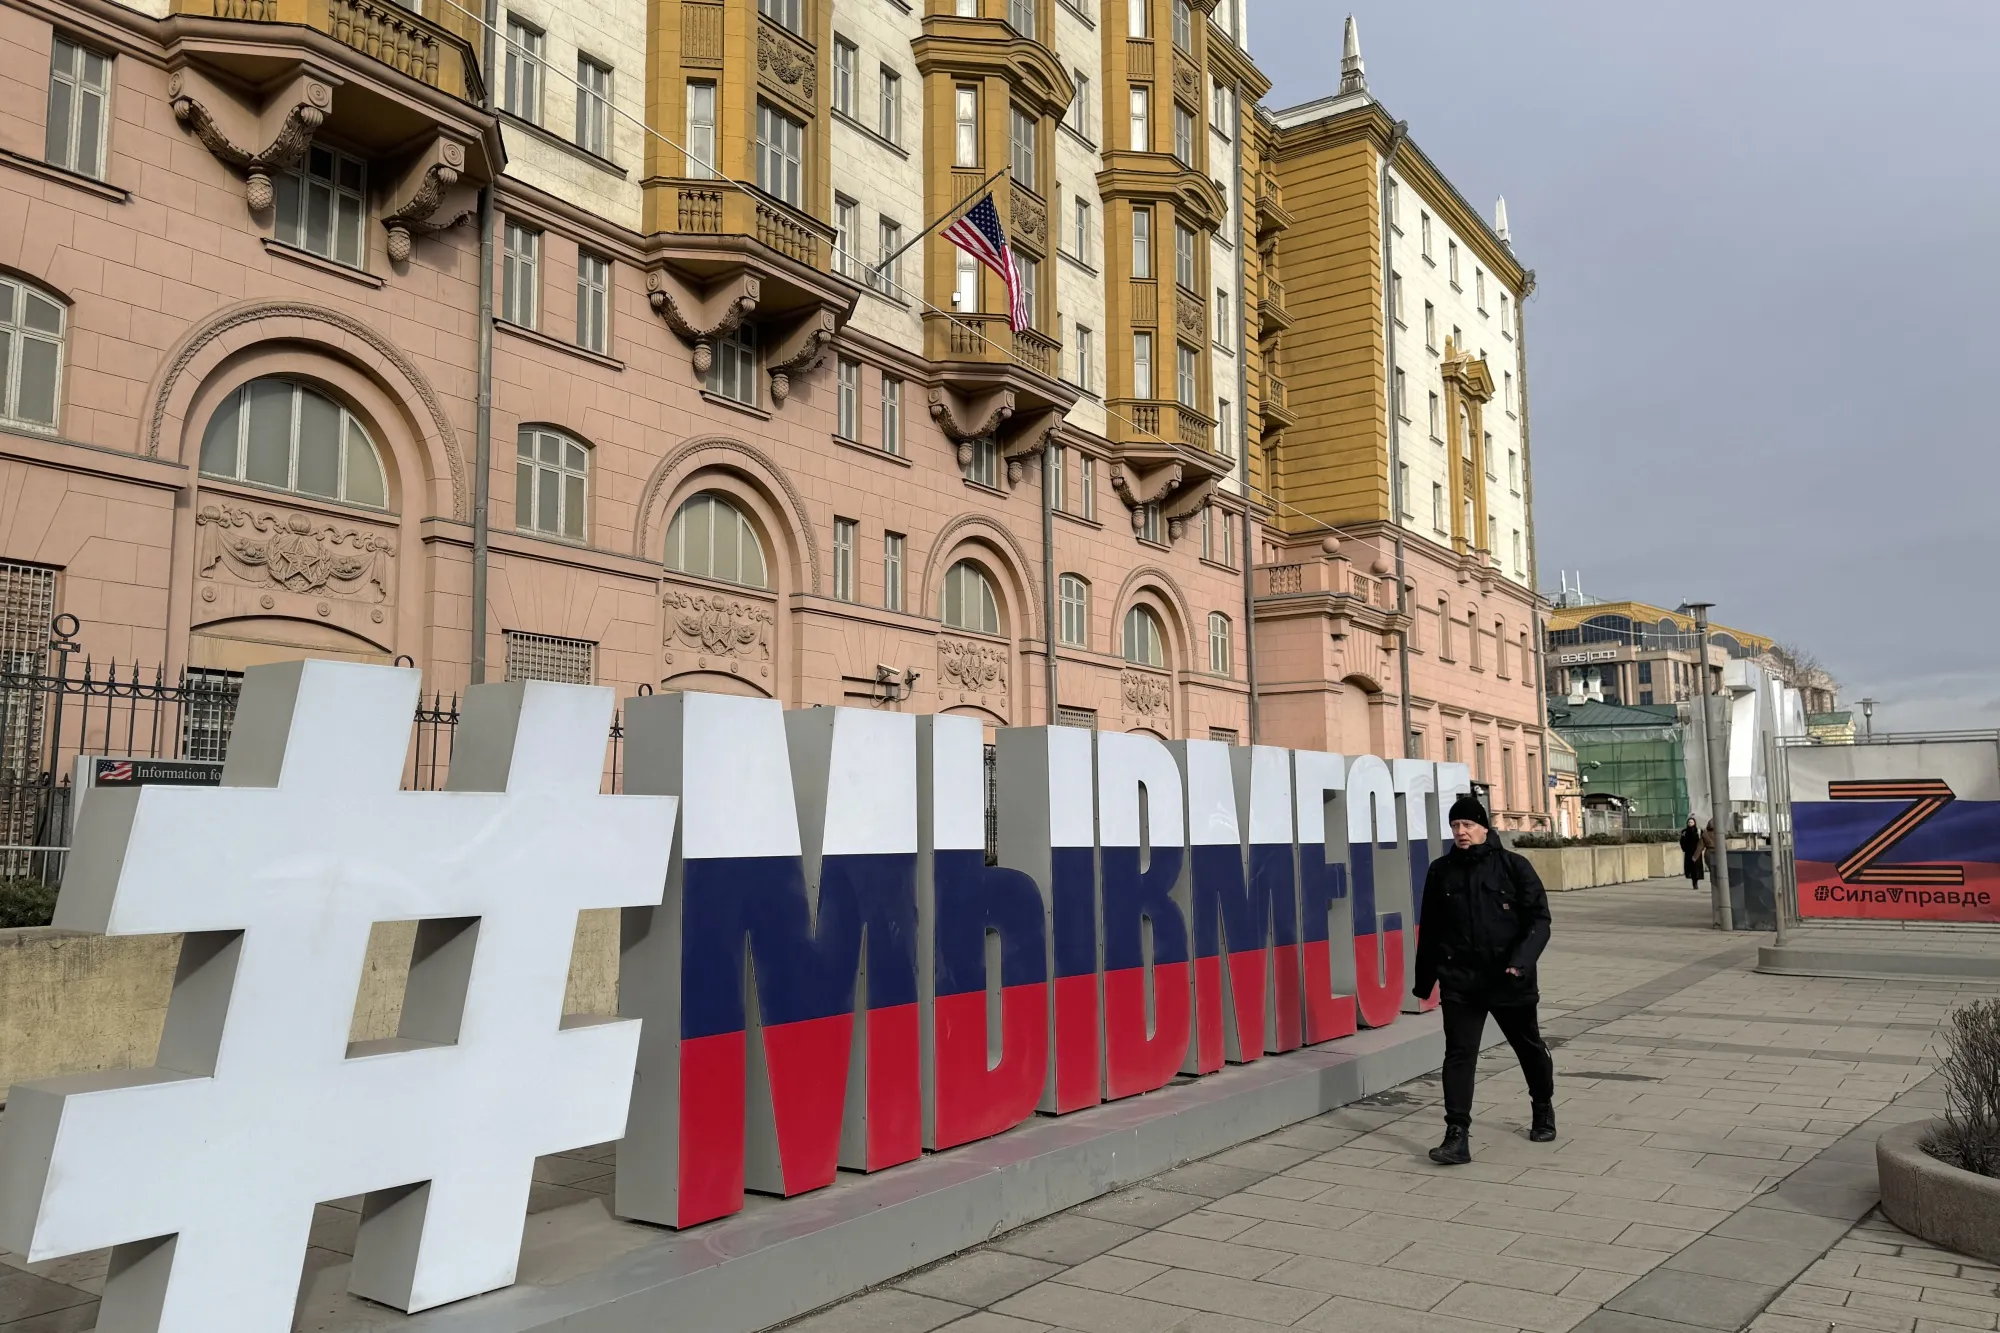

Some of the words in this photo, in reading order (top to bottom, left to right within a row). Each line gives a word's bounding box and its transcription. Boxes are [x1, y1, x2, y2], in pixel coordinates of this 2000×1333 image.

[137, 765, 206, 780] Information
[210, 768, 223, 780] fo
[1828, 778, 1964, 885] Z
[28, 660, 1470, 1333] #МЫВМЕСТ
